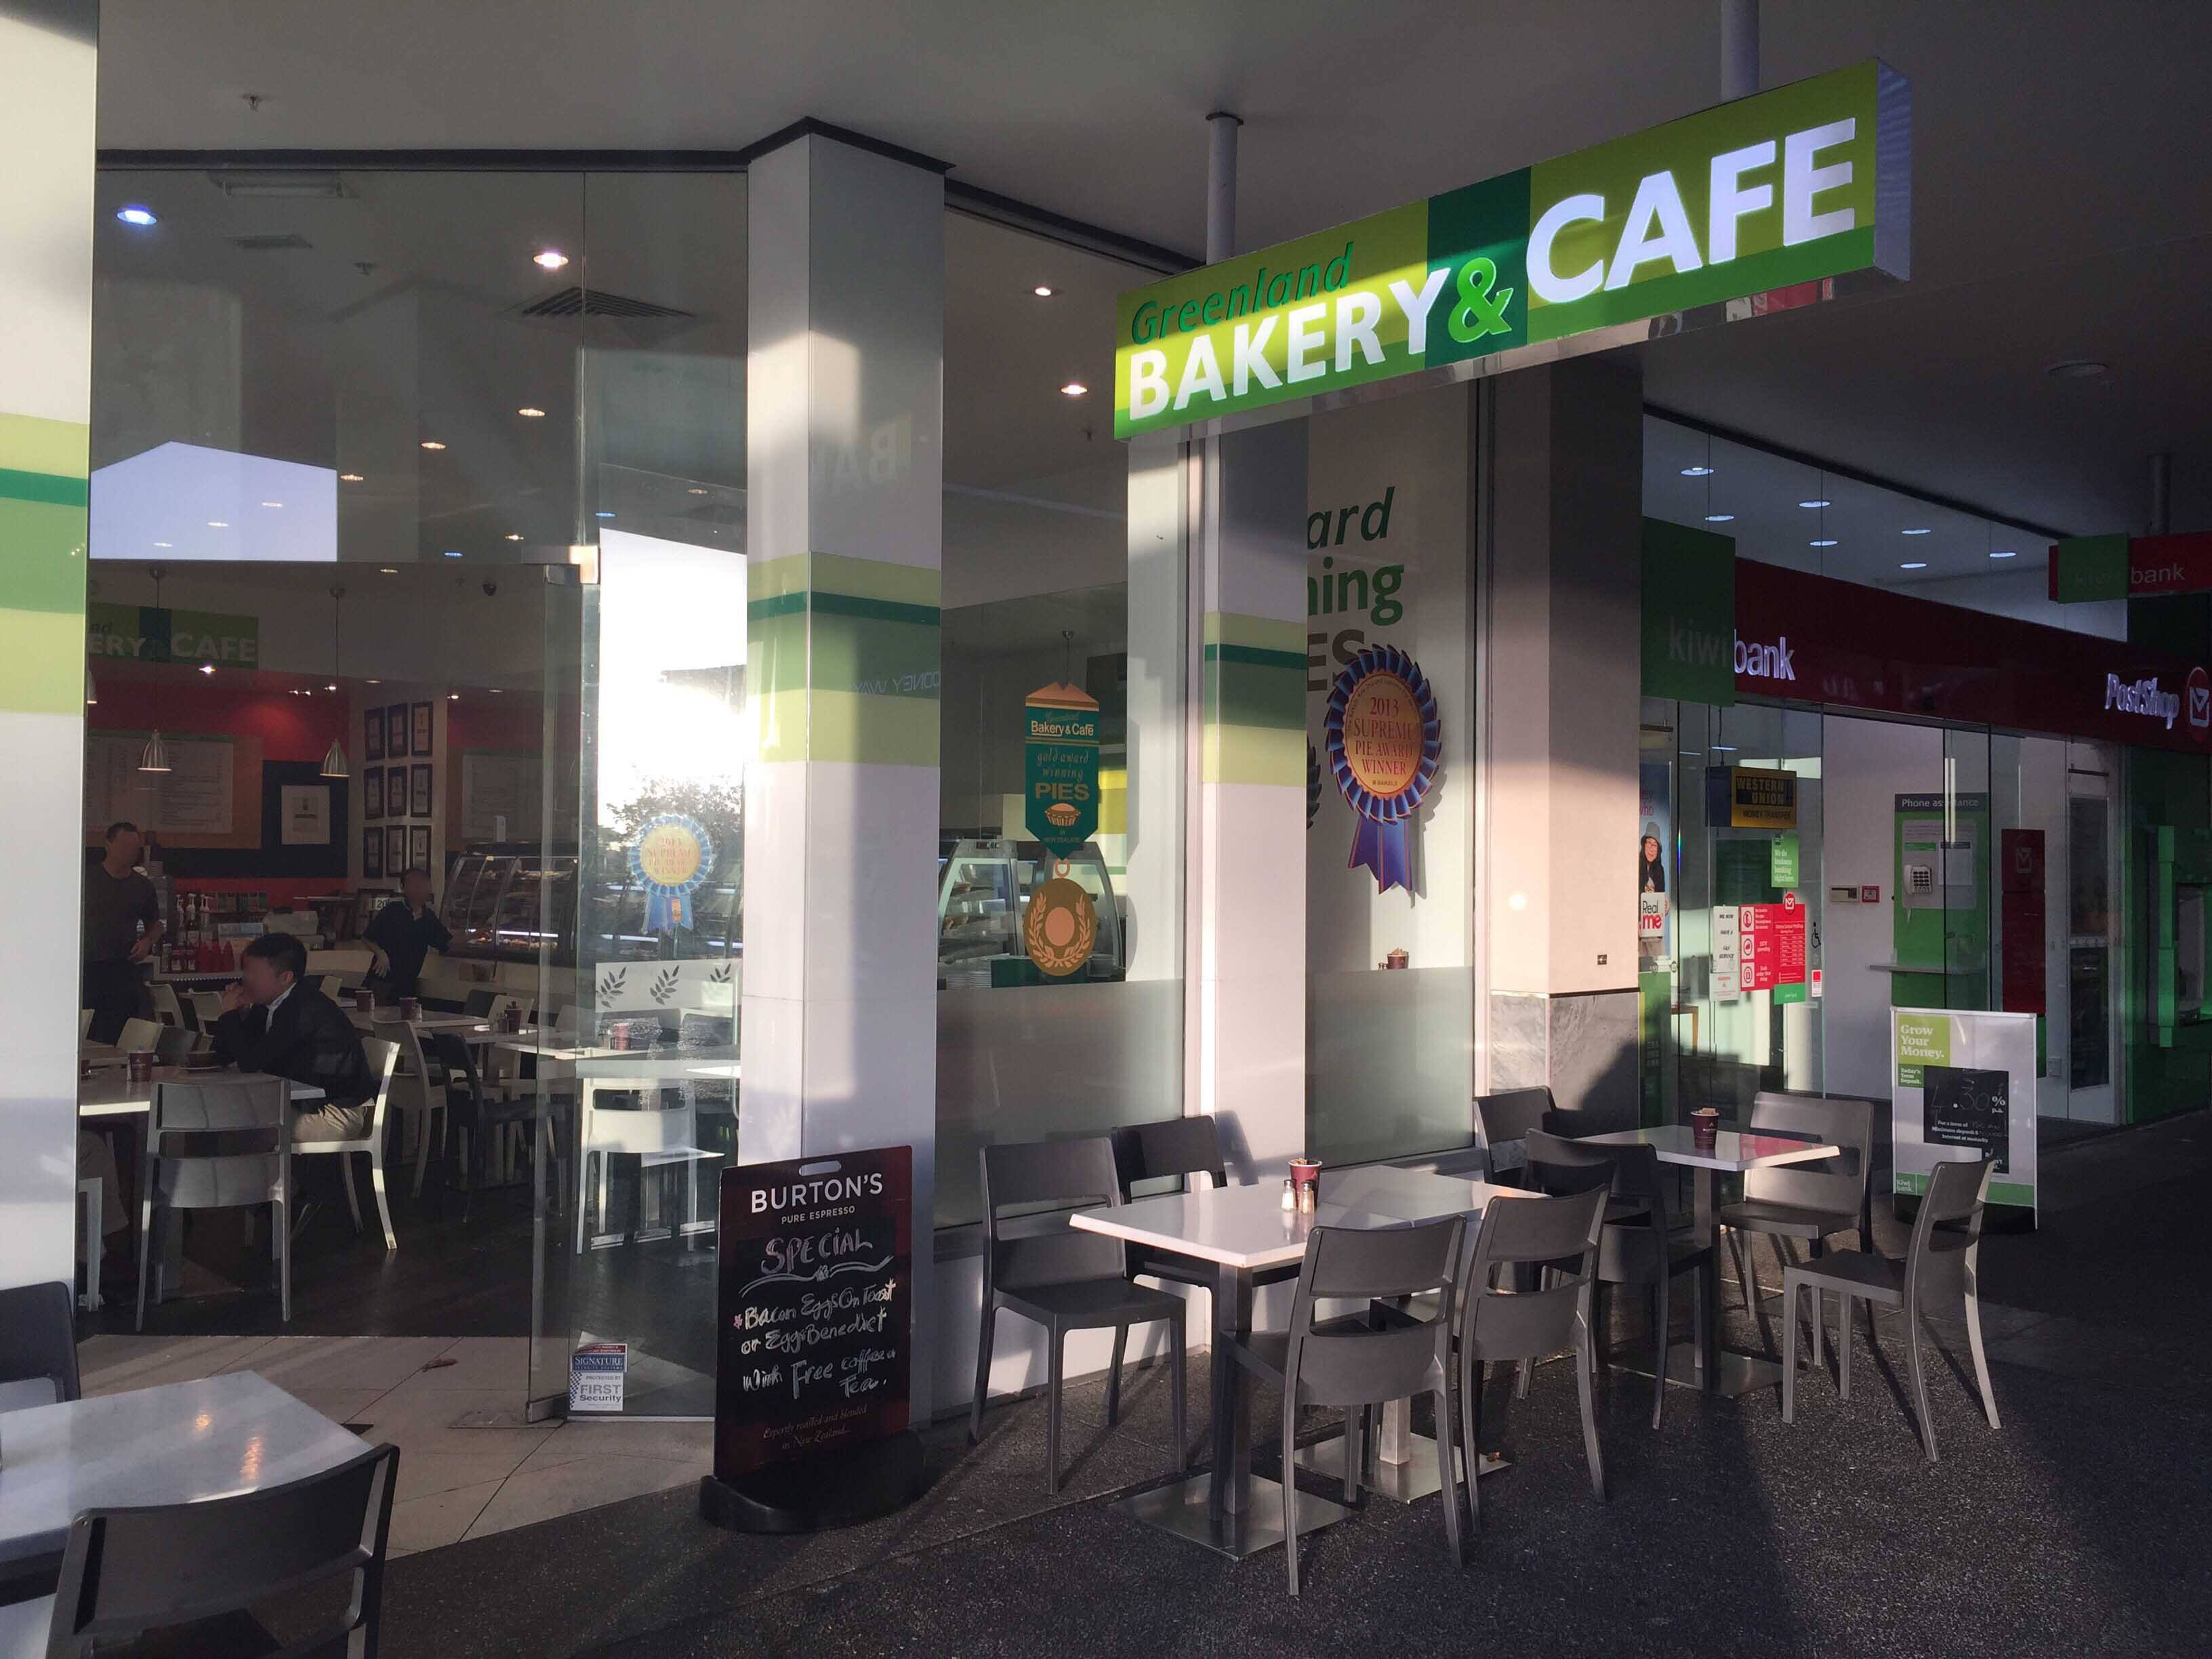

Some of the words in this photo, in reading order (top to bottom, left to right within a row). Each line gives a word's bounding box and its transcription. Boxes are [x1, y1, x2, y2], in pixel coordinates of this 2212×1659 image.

[1129, 267, 1452, 421] BAKERY
[1448, 257, 1514, 344] &
[1525, 117, 1857, 304] CAFE
[1131, 241, 1355, 345] Greenland
[171, 632, 256, 662] CAFE
[1370, 697, 1399, 718] 2013
[2105, 673, 2180, 730] PostShop
[1031, 720, 1064, 737] Bakery
[1353, 718, 1420, 741] SUPREME
[1355, 740, 1372, 756] PIE
[1376, 742, 1414, 760] AWARD
[1361, 758, 1407, 776] WINNER
[1035, 782, 1090, 801] PIES
[1736, 777, 1784, 792] WESTERN
[1752, 792, 1784, 804] UNION
[1902, 799, 1930, 807] Phone
[1933, 798, 1980, 807] asance
[1642, 900, 1659, 914] Real
[1641, 914, 1662, 930] me
[1900, 1025, 1933, 1035] Grow
[1901, 1036, 1930, 1046] Your
[1900, 1046, 1944, 1060] Money.
[752, 1172, 883, 1213] BURTON'S
[781, 1213, 806, 1225] PURE
[809, 1206, 855, 1221] ESPRESSO
[745, 1306, 796, 1330] Bacon
[800, 1292, 838, 1321] Eggs
[838, 1287, 860, 1308] On
[862, 1277, 897, 1305] Toast
[741, 1338, 761, 1354] or
[575, 1356, 623, 1366] SIGNATURE
[790, 1359, 834, 1399] Free
[579, 1395, 621, 1403] Security
[580, 1385, 621, 1395] FIRST
[825, 1410, 838, 1422] and
[840, 1404, 867, 1419] blended
